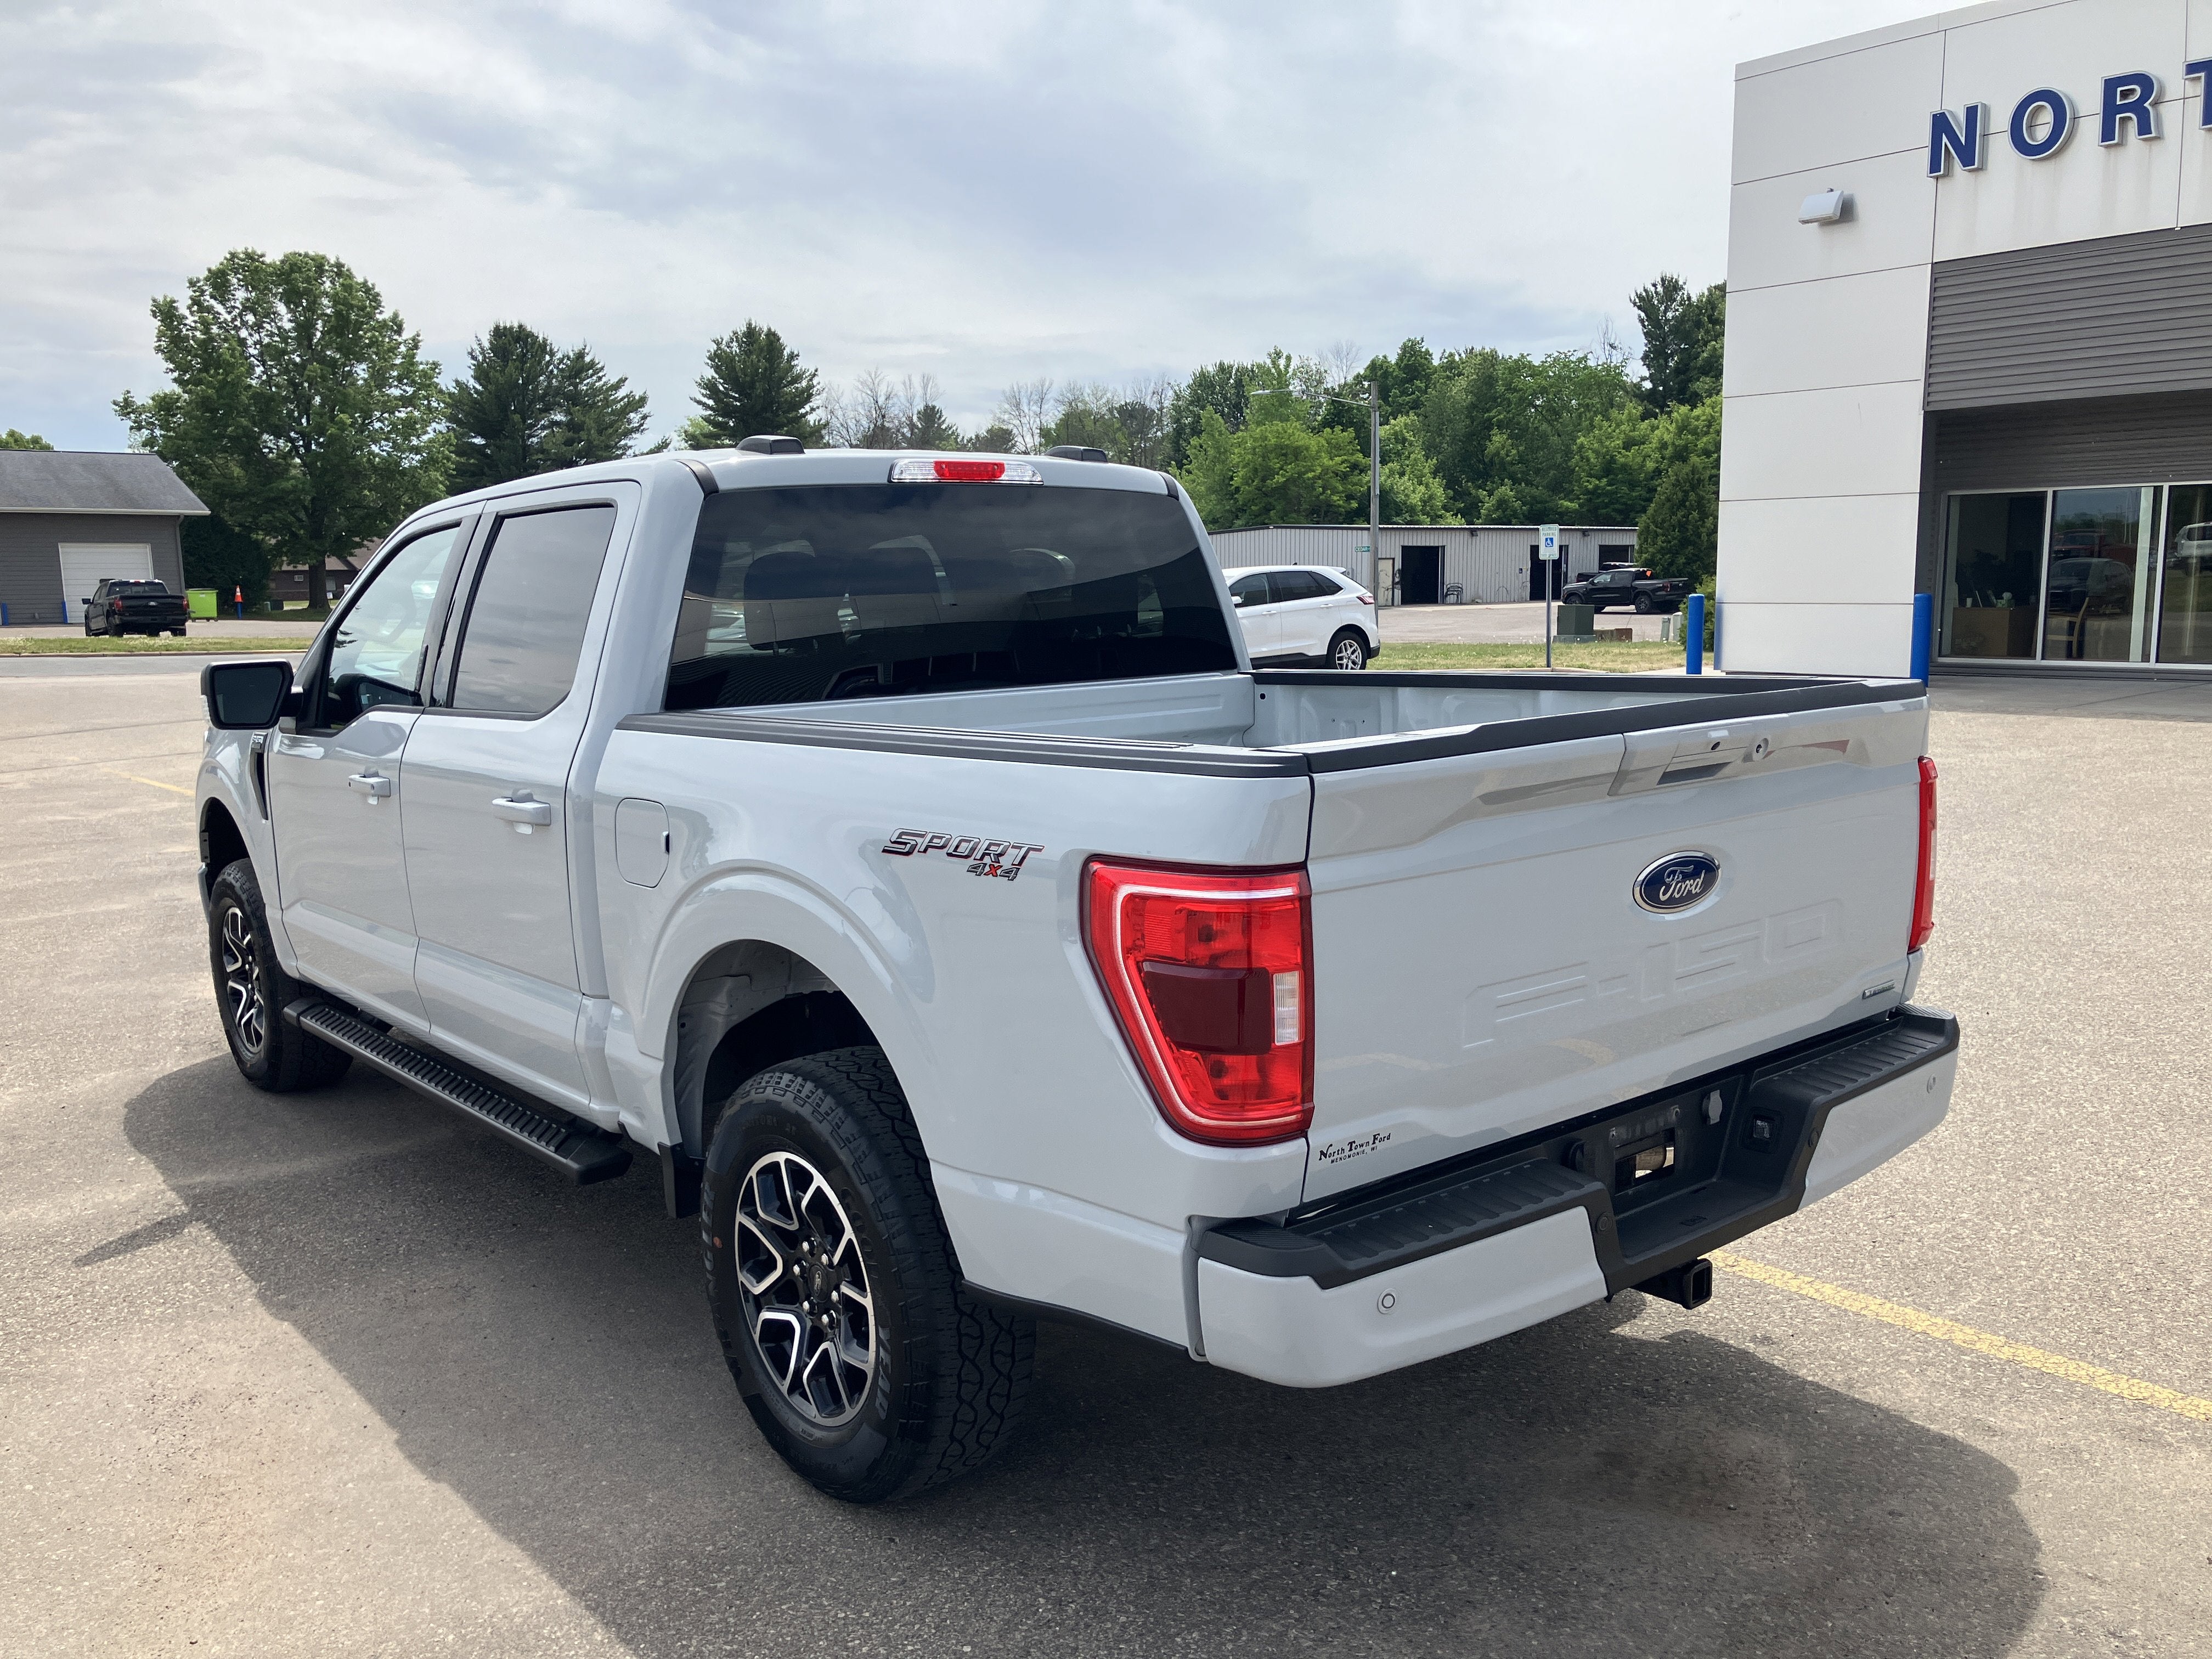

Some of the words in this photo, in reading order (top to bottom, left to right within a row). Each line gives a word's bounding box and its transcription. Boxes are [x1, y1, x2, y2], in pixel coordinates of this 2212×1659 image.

[1926, 57, 2212, 178] NORT
[882, 827, 1045, 867] SPORT
[1659, 865, 1705, 901] Ford
[1318, 1143, 1345, 1161] North
[1347, 1140, 1370, 1153] Town
[1371, 1132, 1392, 1146] Ford
